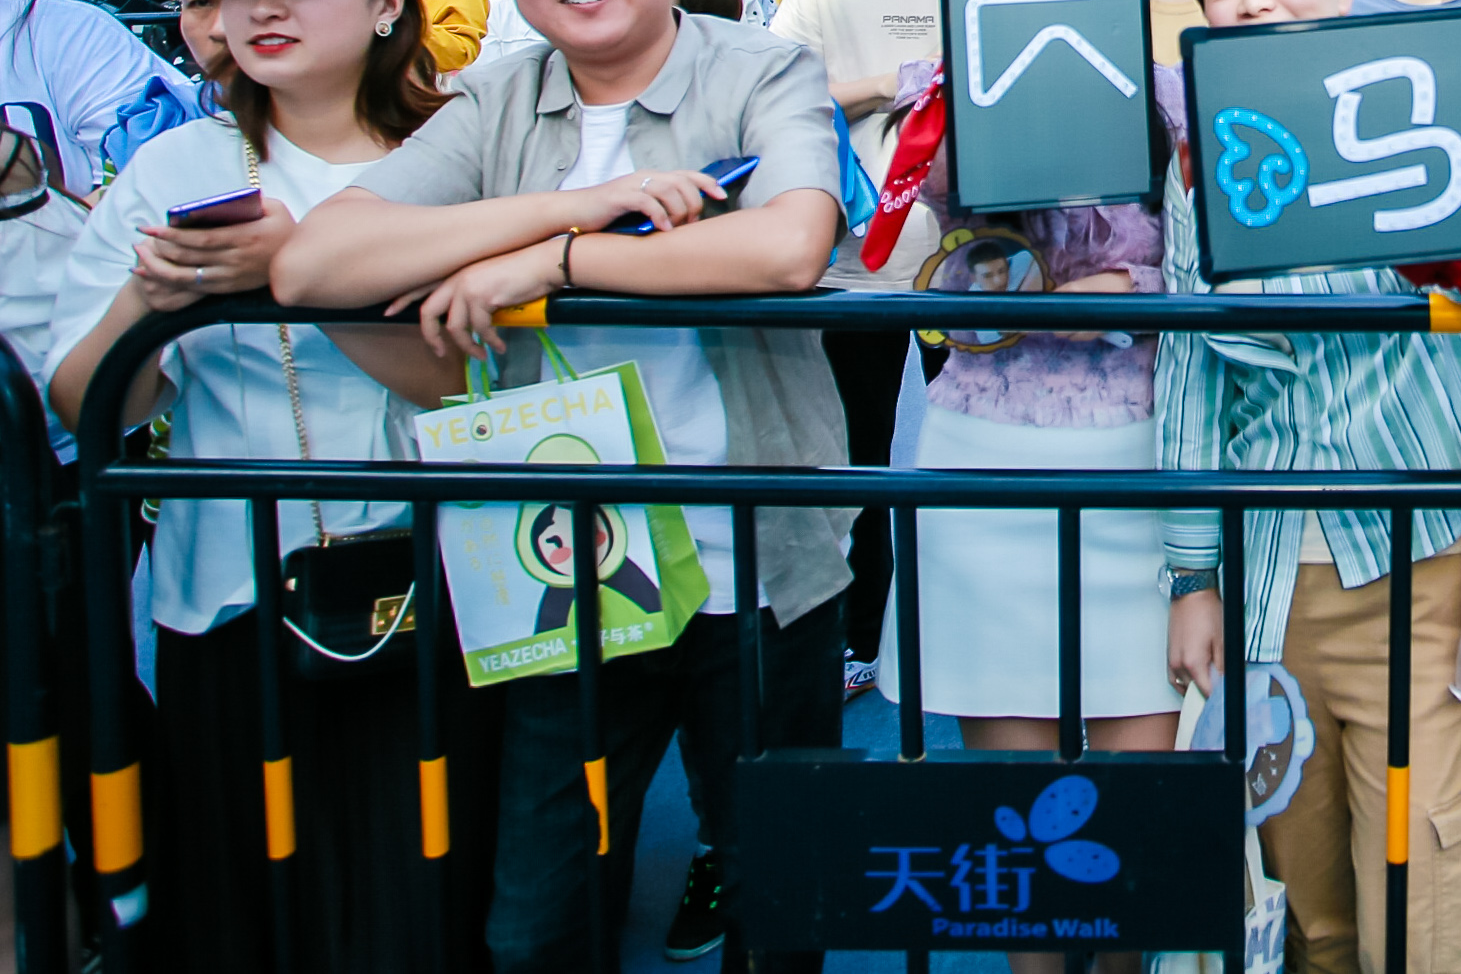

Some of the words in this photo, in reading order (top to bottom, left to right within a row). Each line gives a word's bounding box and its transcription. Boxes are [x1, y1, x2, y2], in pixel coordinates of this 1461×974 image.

[882, 15, 935, 24] PANAMA
[478, 635, 568, 674] YEAZECHA
[864, 842, 1037, 913] 天街
[931, 917, 1048, 939] Paradise
[1052, 917, 1120, 939] Walk
